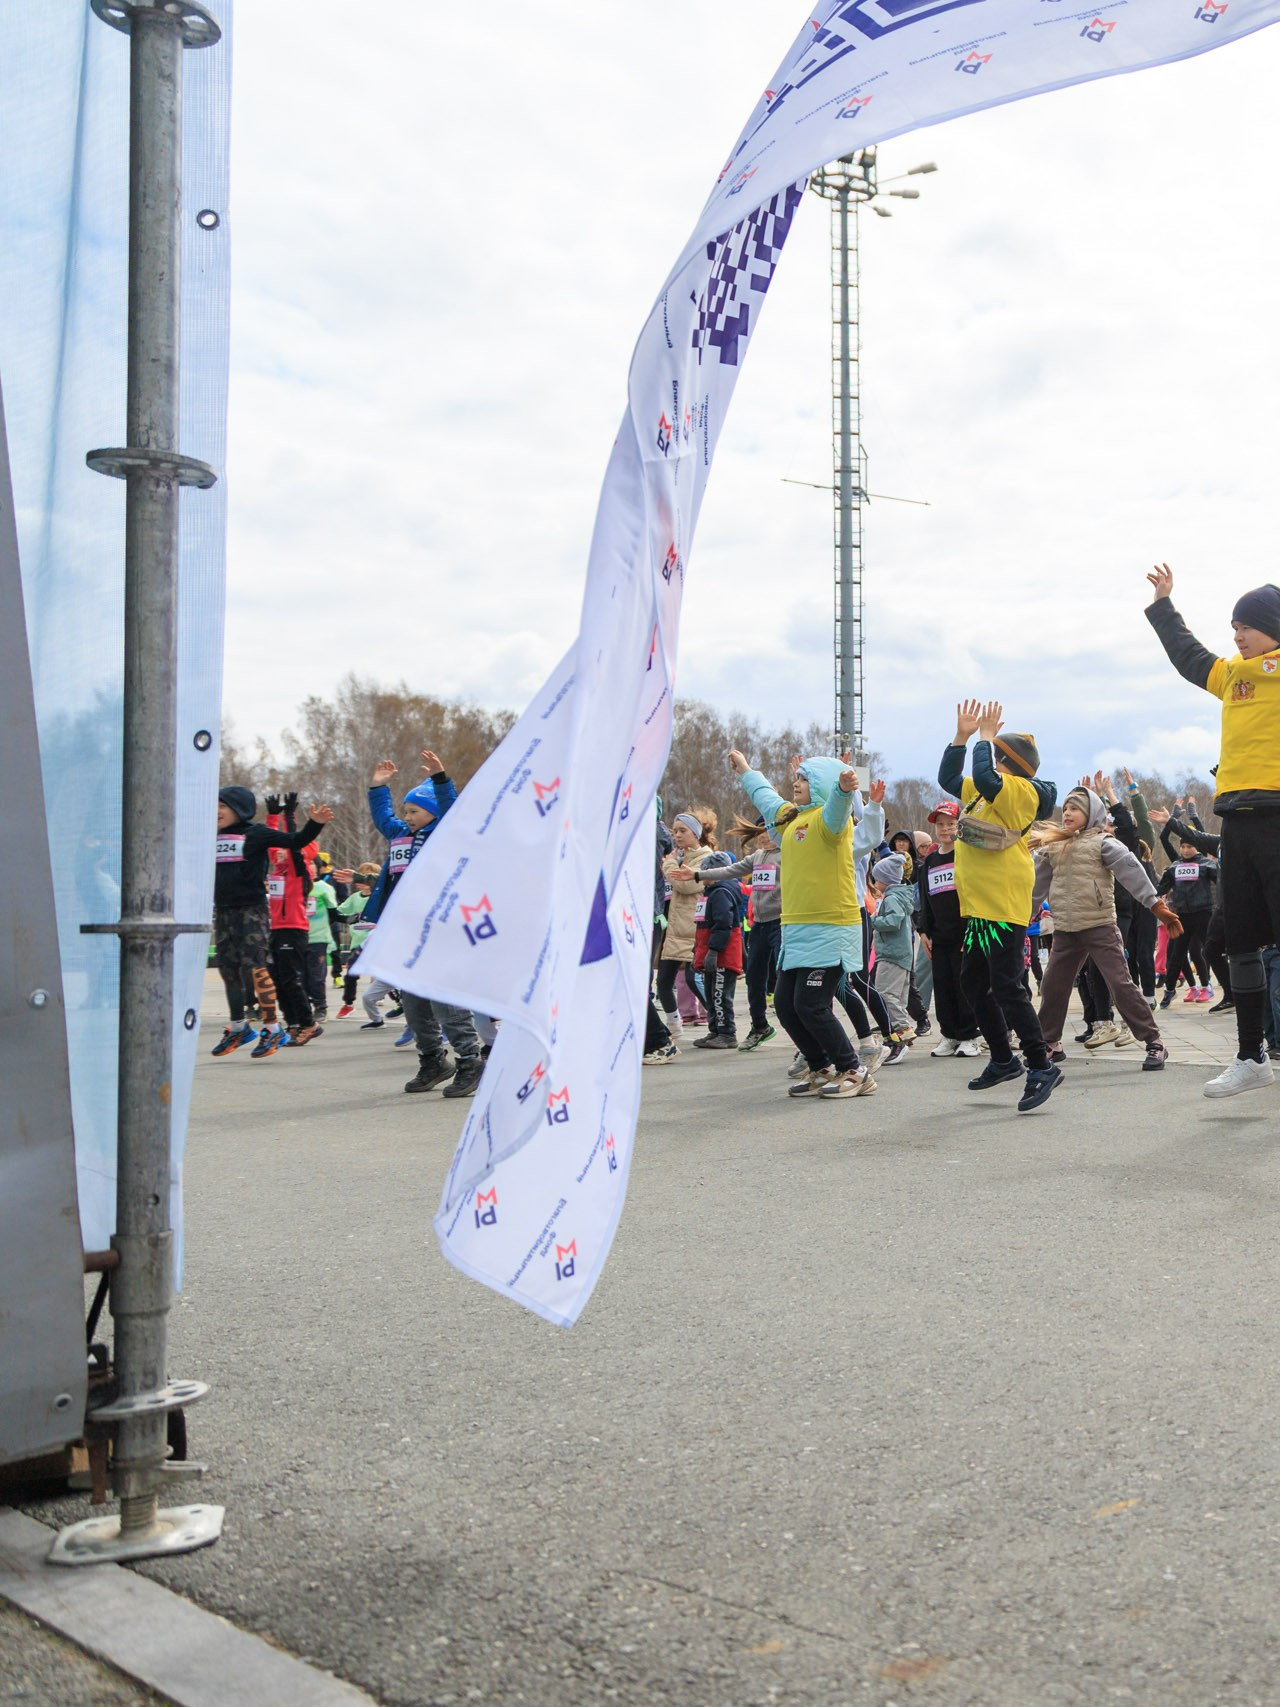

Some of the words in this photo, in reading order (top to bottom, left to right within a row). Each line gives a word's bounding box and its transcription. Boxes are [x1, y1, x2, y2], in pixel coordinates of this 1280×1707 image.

[216, 843, 236, 853] 224
[391, 849, 412, 861] 168
[933, 872, 953, 885] 5112
